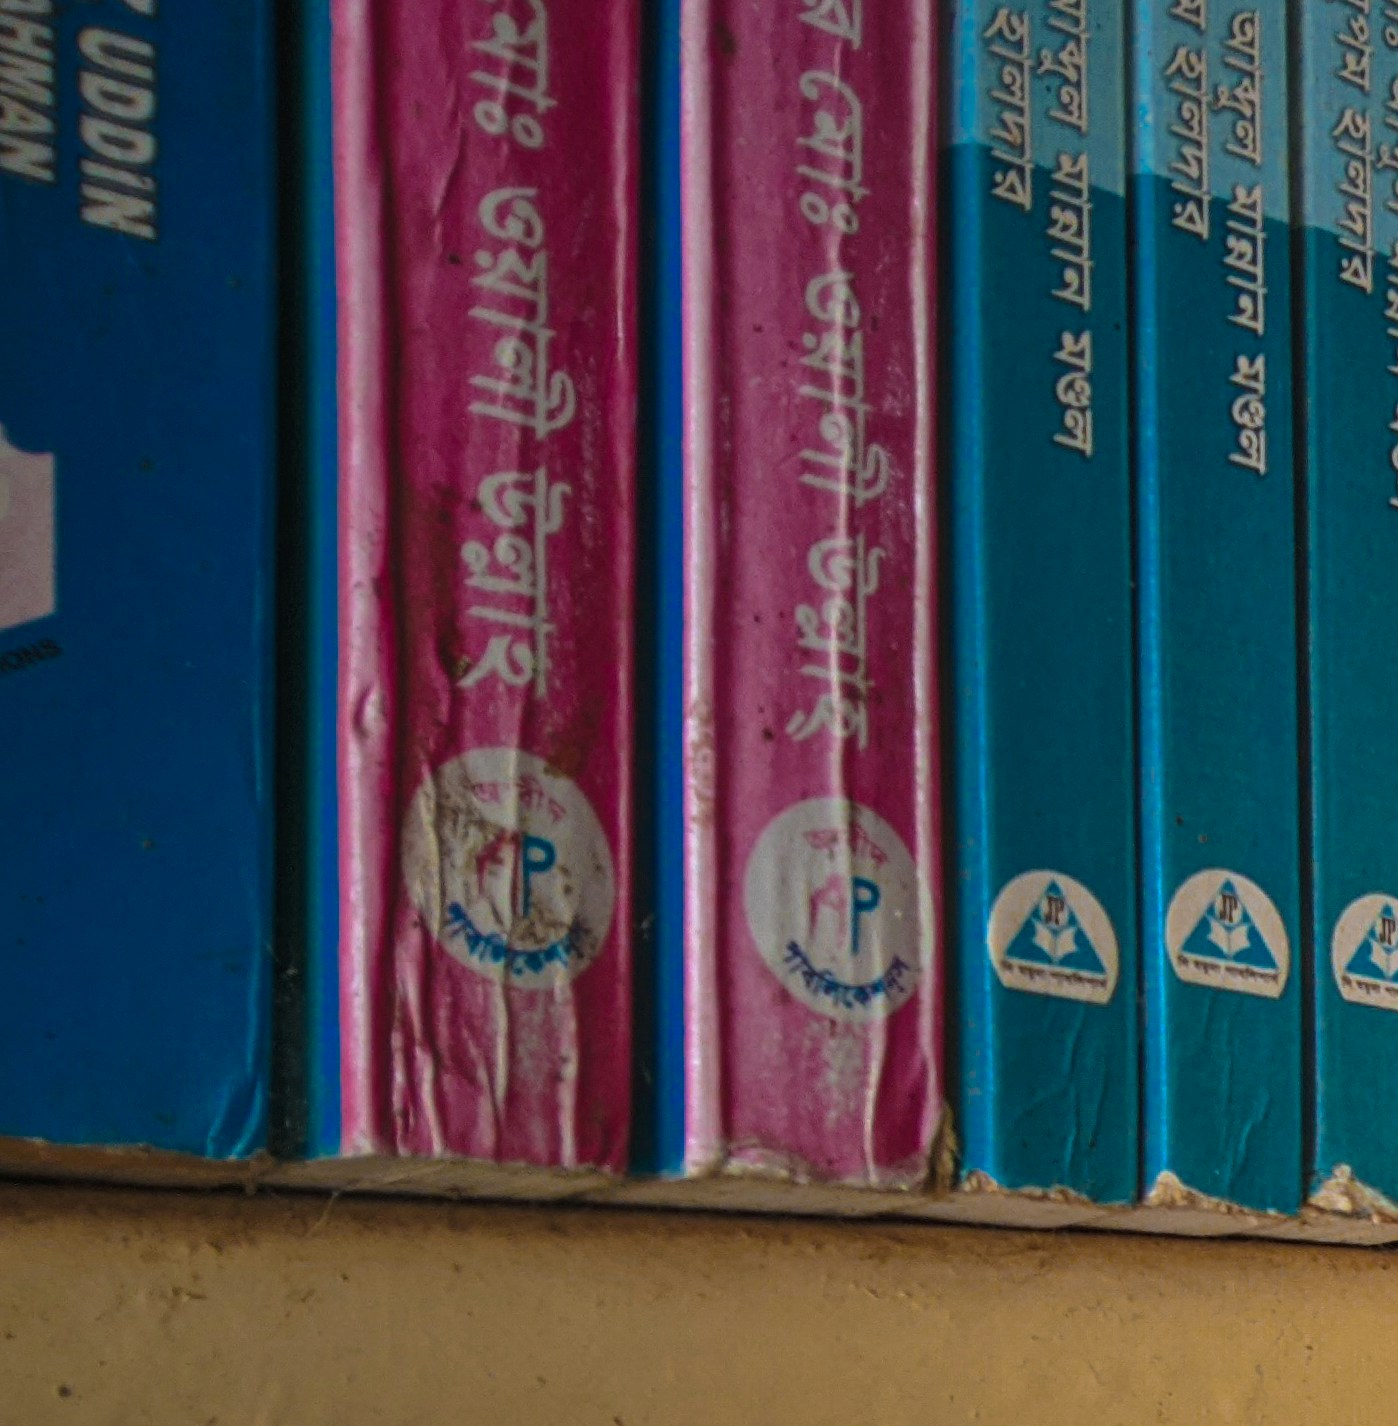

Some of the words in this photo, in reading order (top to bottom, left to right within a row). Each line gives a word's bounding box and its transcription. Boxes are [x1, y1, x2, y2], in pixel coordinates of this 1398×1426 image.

[76, 25, 157, 242] UDDIN
[799, 70, 869, 235] মোঃ
[983, 8, 1033, 212] হালদার
[1163, 45, 1211, 240] হালদার
[1332, 108, 1374, 294] হালদার
[466, 186, 577, 437] ওয়ালী
[799, 270, 888, 507] ওয়ালী
